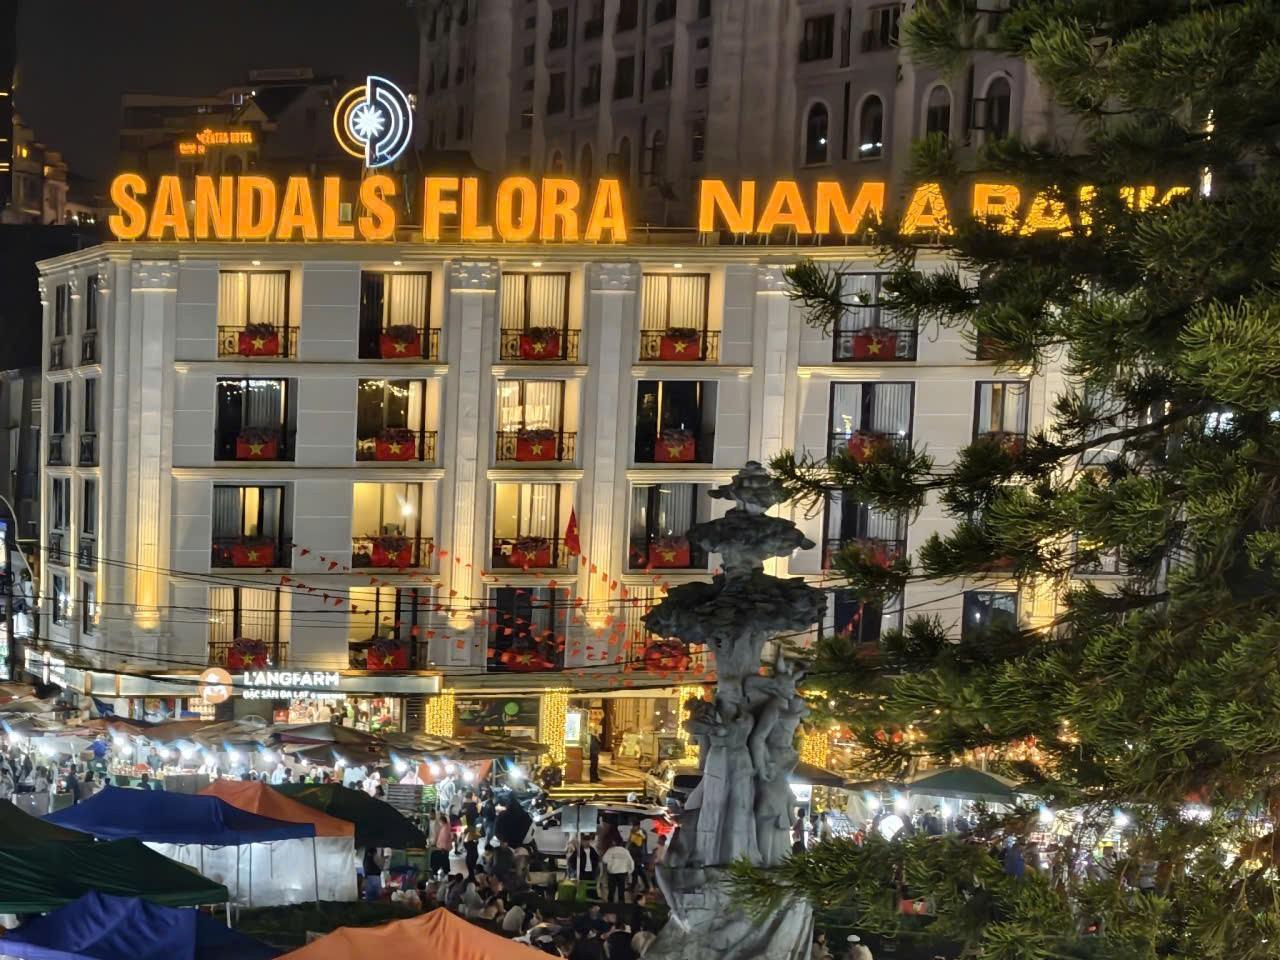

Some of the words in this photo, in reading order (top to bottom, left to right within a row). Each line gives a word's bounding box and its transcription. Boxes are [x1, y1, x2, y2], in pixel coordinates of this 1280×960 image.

[109, 173, 397, 240] SANDALS
[423, 176, 627, 242] FLORA
[699, 180, 885, 234] NAM
[898, 183, 955, 236] A
[243, 671, 339, 686] L'ANGFARM
